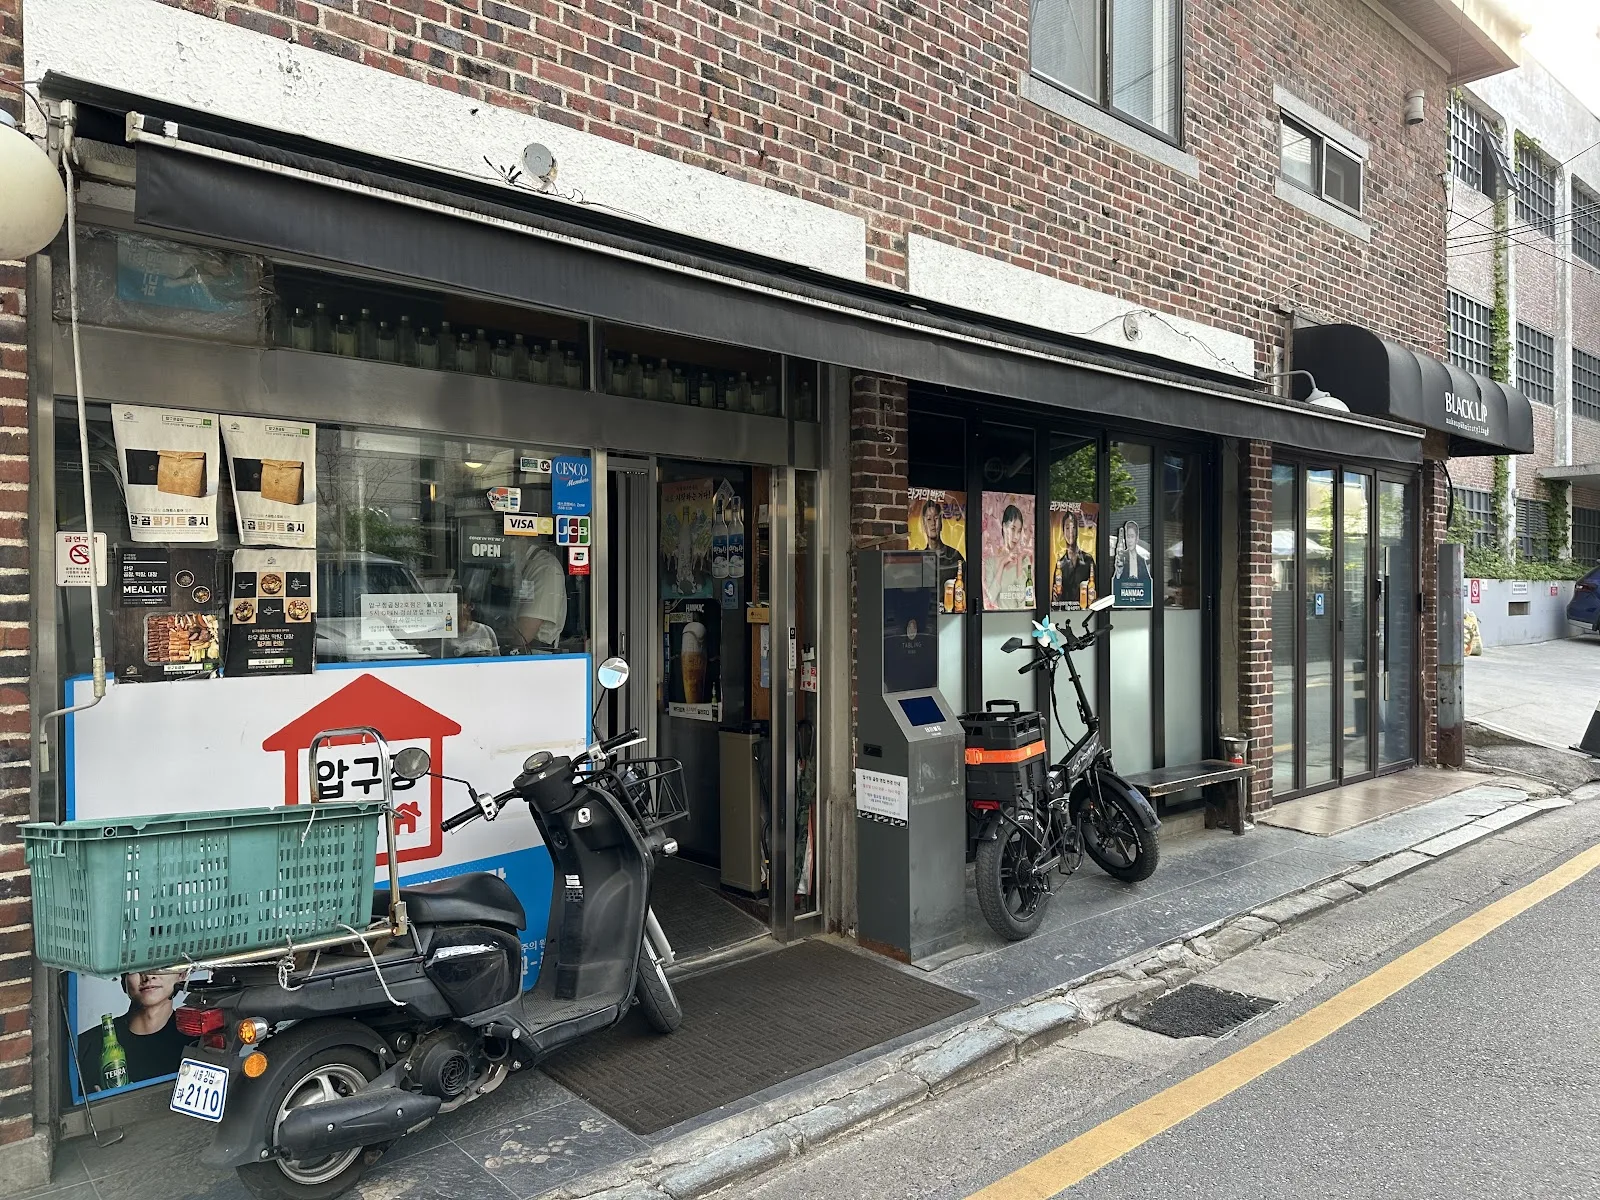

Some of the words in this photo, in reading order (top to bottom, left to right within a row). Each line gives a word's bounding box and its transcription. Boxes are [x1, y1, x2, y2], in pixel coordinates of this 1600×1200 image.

[1445, 391, 1475, 421] BLACK
[1475, 402, 1488, 424] LIP
[556, 461, 588, 476] CESCO
[566, 476, 589, 487] Members
[509, 518, 534, 529] VISA
[558, 525, 588, 536] JCB
[471, 543, 501, 558] OPEN
[123, 586, 150, 594] MEAL
[152, 585, 167, 594] KIT
[1120, 588, 1145, 597] HANMAC
[105, 1066, 126, 1080] TERRA
[203, 1070, 216, 1085] 강남
[185, 1084, 219, 1112] 2110
